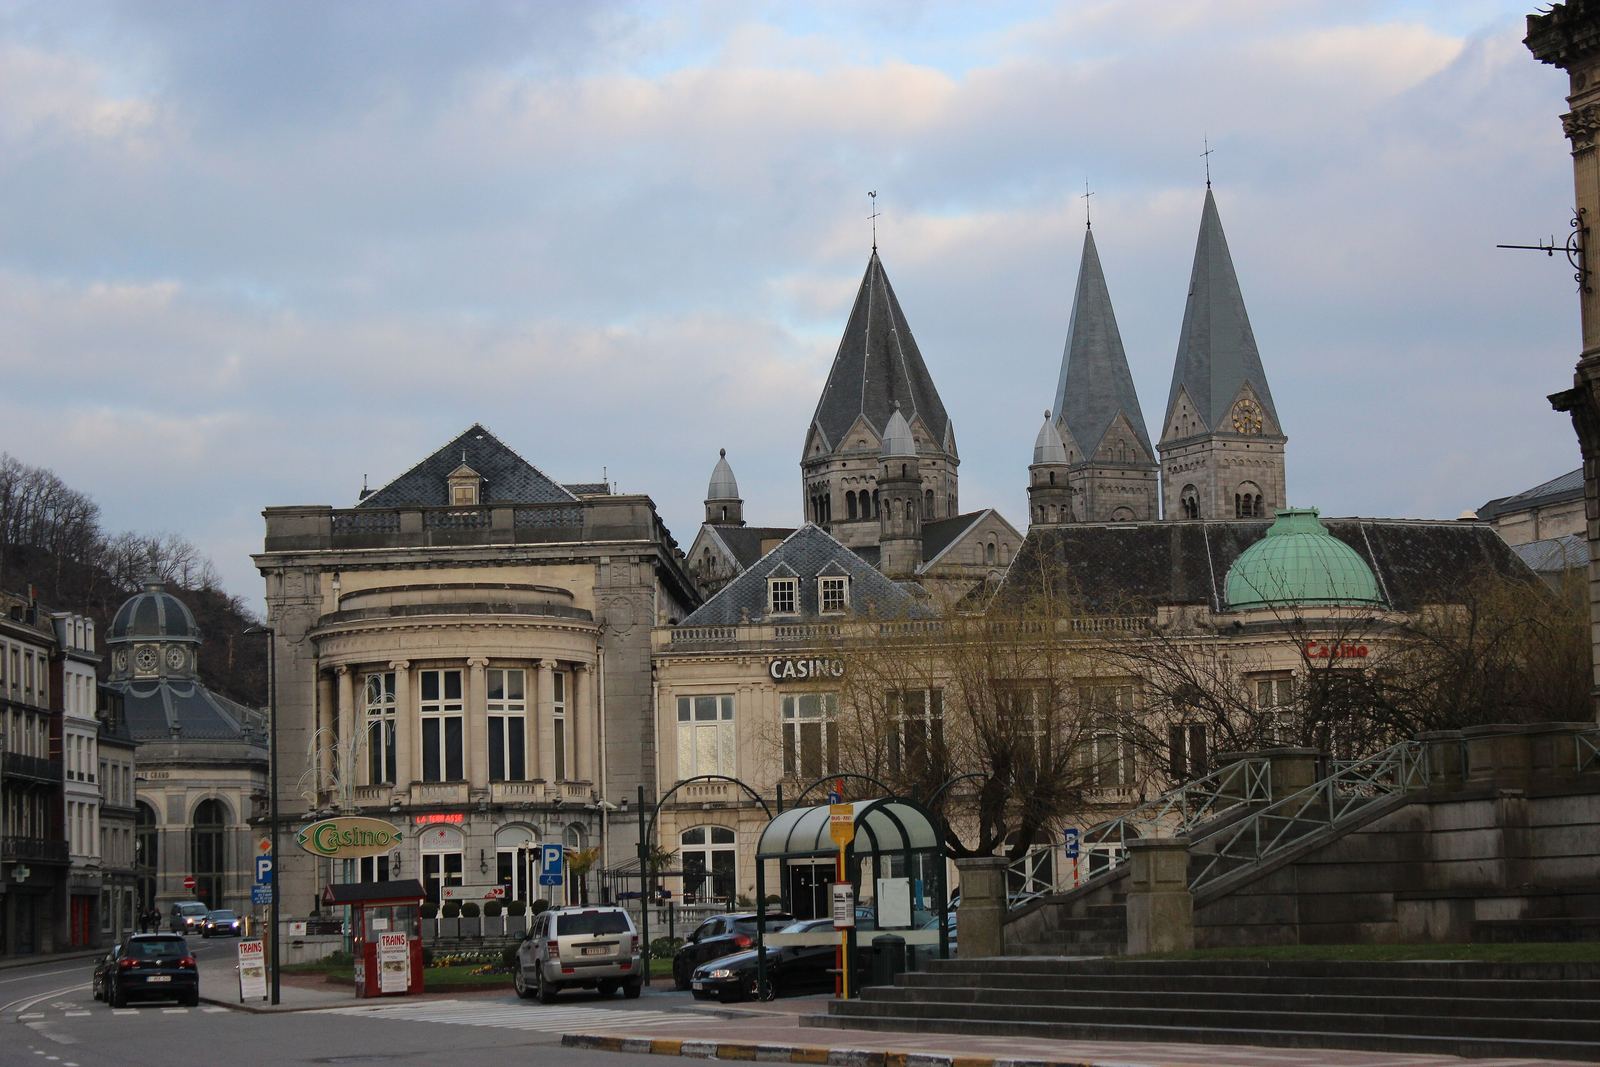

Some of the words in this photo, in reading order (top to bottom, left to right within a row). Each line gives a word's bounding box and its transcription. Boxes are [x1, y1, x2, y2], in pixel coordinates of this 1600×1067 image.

[770, 659, 844, 679] CASINO
[313, 822, 391, 855] Casino
[545, 848, 560, 871] P
[258, 860, 273, 880] P
[239, 942, 262, 954] TRAINS
[381, 934, 405, 947] TRAINS
